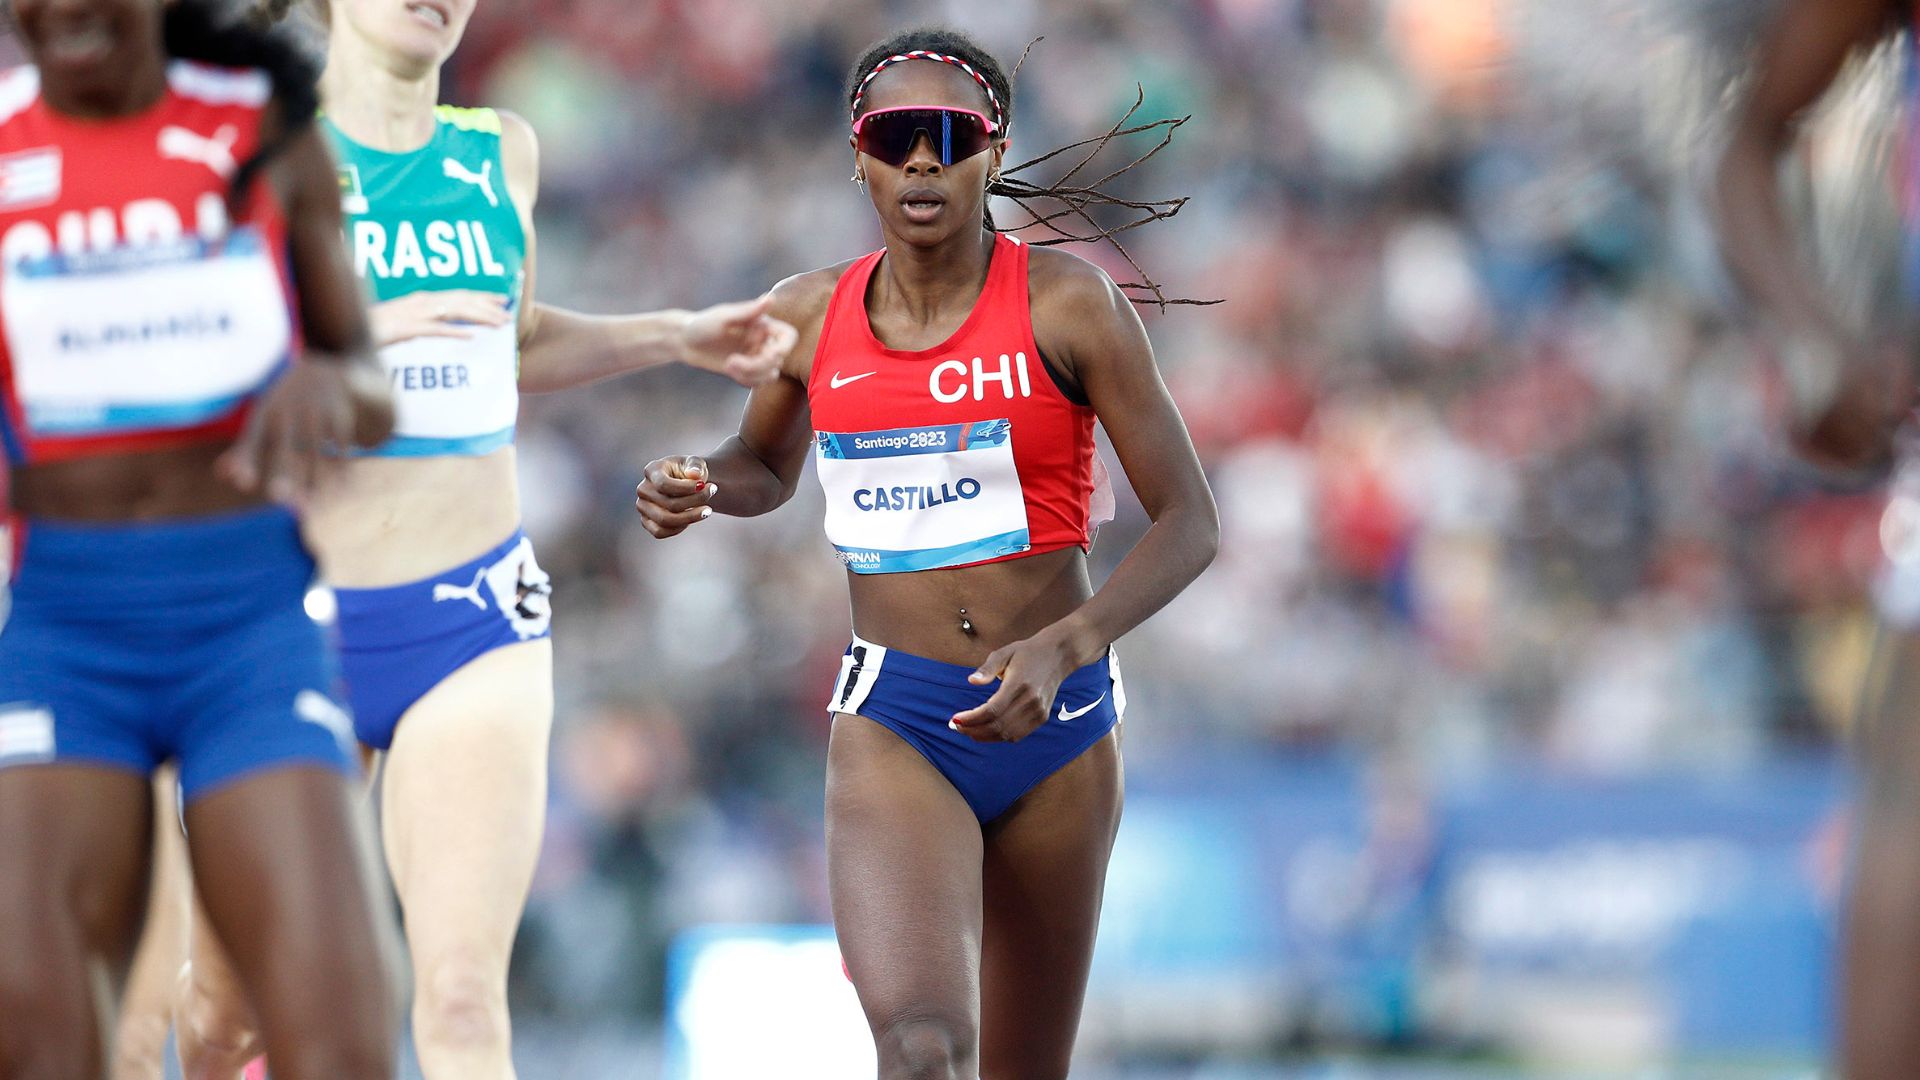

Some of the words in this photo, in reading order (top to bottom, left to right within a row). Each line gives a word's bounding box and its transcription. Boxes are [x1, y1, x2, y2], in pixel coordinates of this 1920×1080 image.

[339, 219, 505, 278] RASIL
[929, 351, 1031, 403] CHI
[855, 437, 908, 450] Santiago
[909, 431, 947, 448] 2023
[853, 477, 981, 512] CASTILLO
